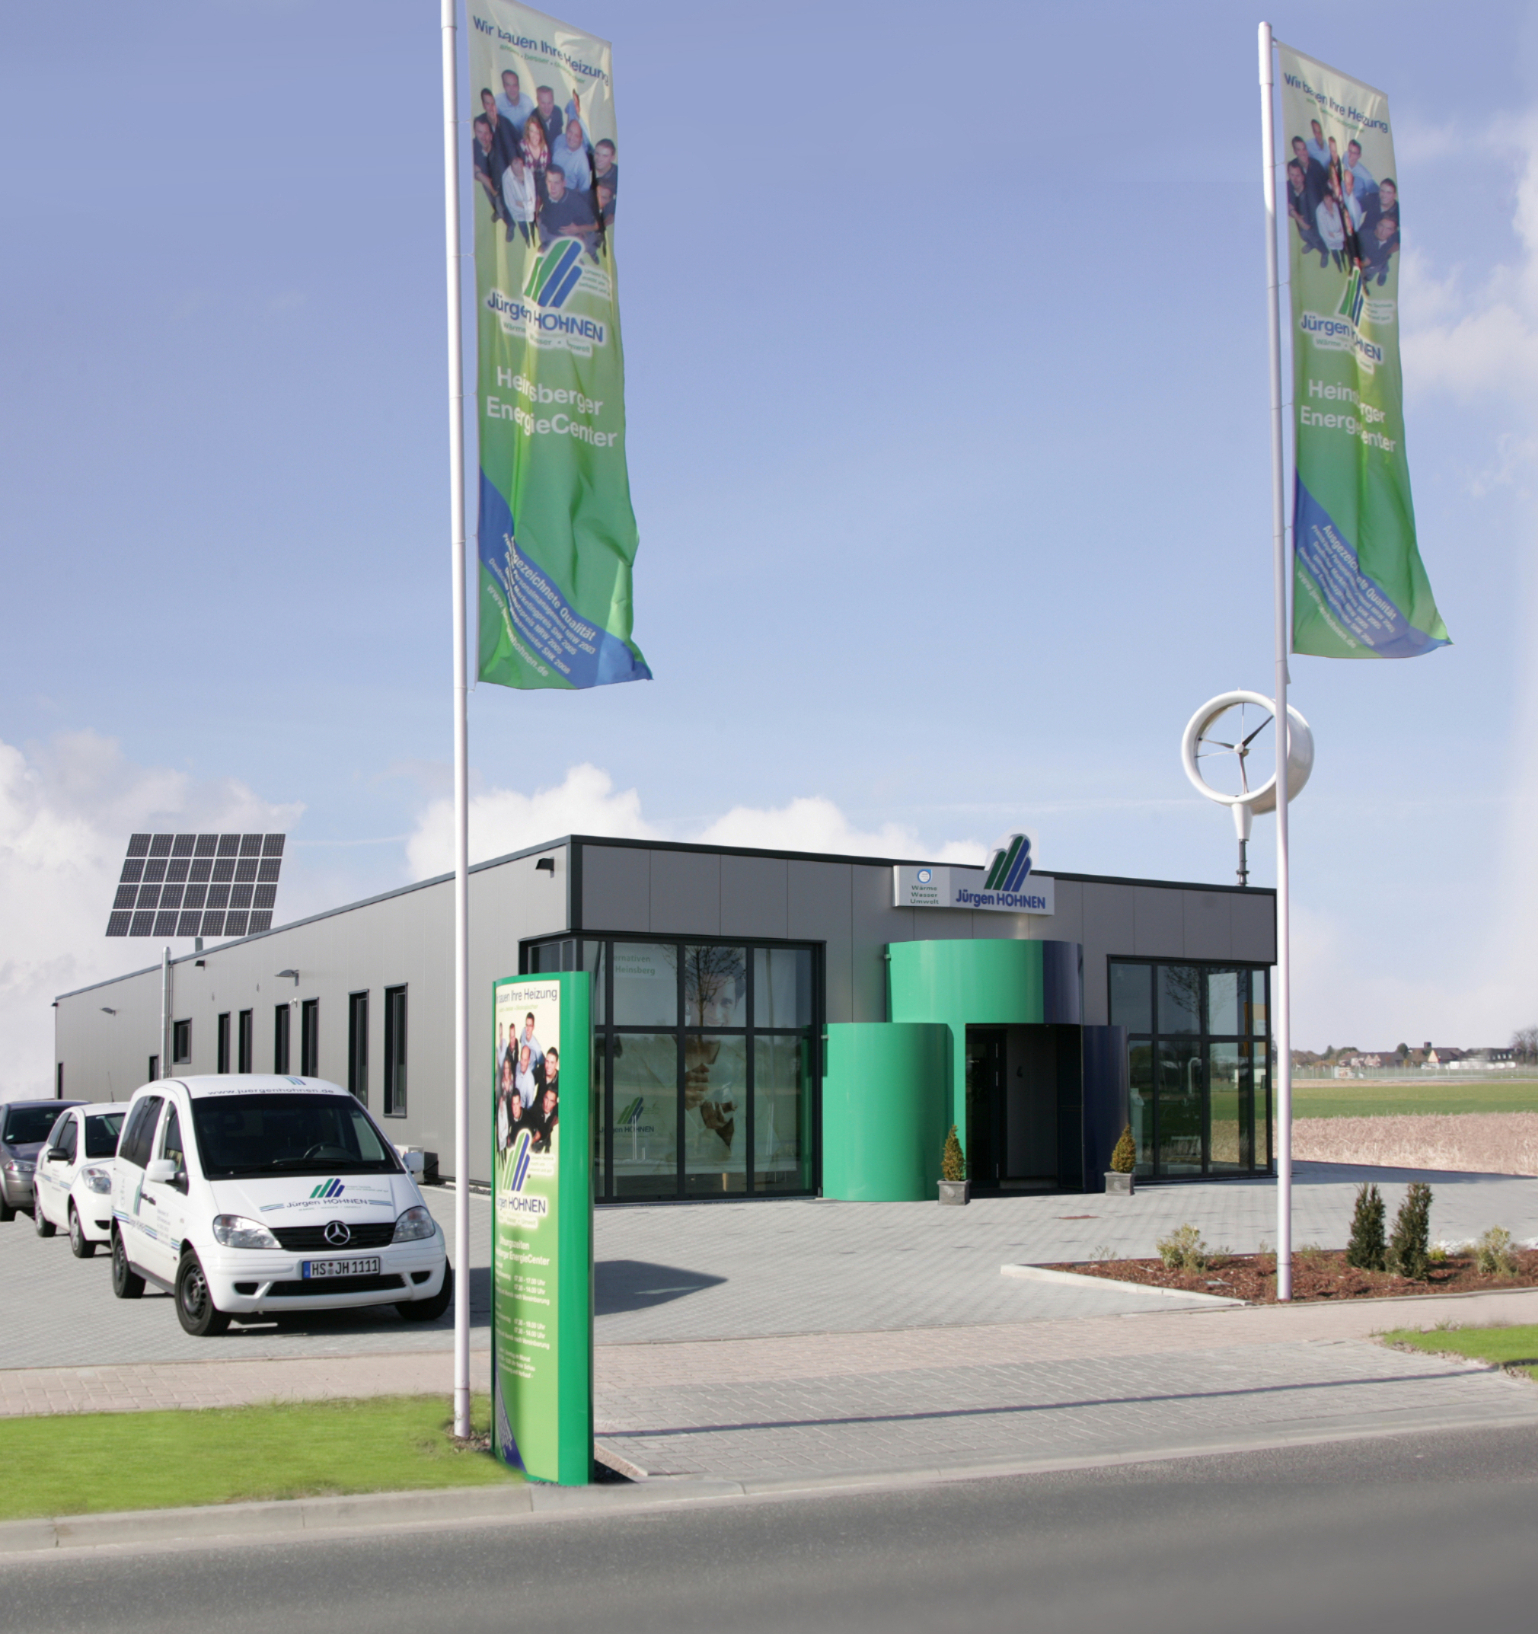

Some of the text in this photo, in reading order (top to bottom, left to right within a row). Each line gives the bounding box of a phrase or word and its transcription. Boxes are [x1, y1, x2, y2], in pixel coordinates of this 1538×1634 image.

[473, 15, 494, 36] Wir
[1348, 106, 1389, 134] Heizung
[487, 292, 604, 343] Jürgen HOHNEN
[1301, 314, 1351, 337] Jürgen
[1308, 379, 1386, 423] Heinrger
[486, 395, 619, 448] EnergieCenter
[1300, 405, 1397, 453] Energenter
[1365, 588, 1397, 621] Qualität
[559, 607, 597, 641] Qualität
[956, 889, 1046, 910] Jürgen HOHNEN
[615, 965, 656, 976] Heinsberg
[524, 987, 558, 1002] Heizung
[207, 1087, 334, 1096] www.juergenhohnen.de
[286, 1199, 321, 1208] Jürgen
[509, 1197, 546, 1214] HOHNEN
[312, 1259, 378, 1276] HS JH 1111
